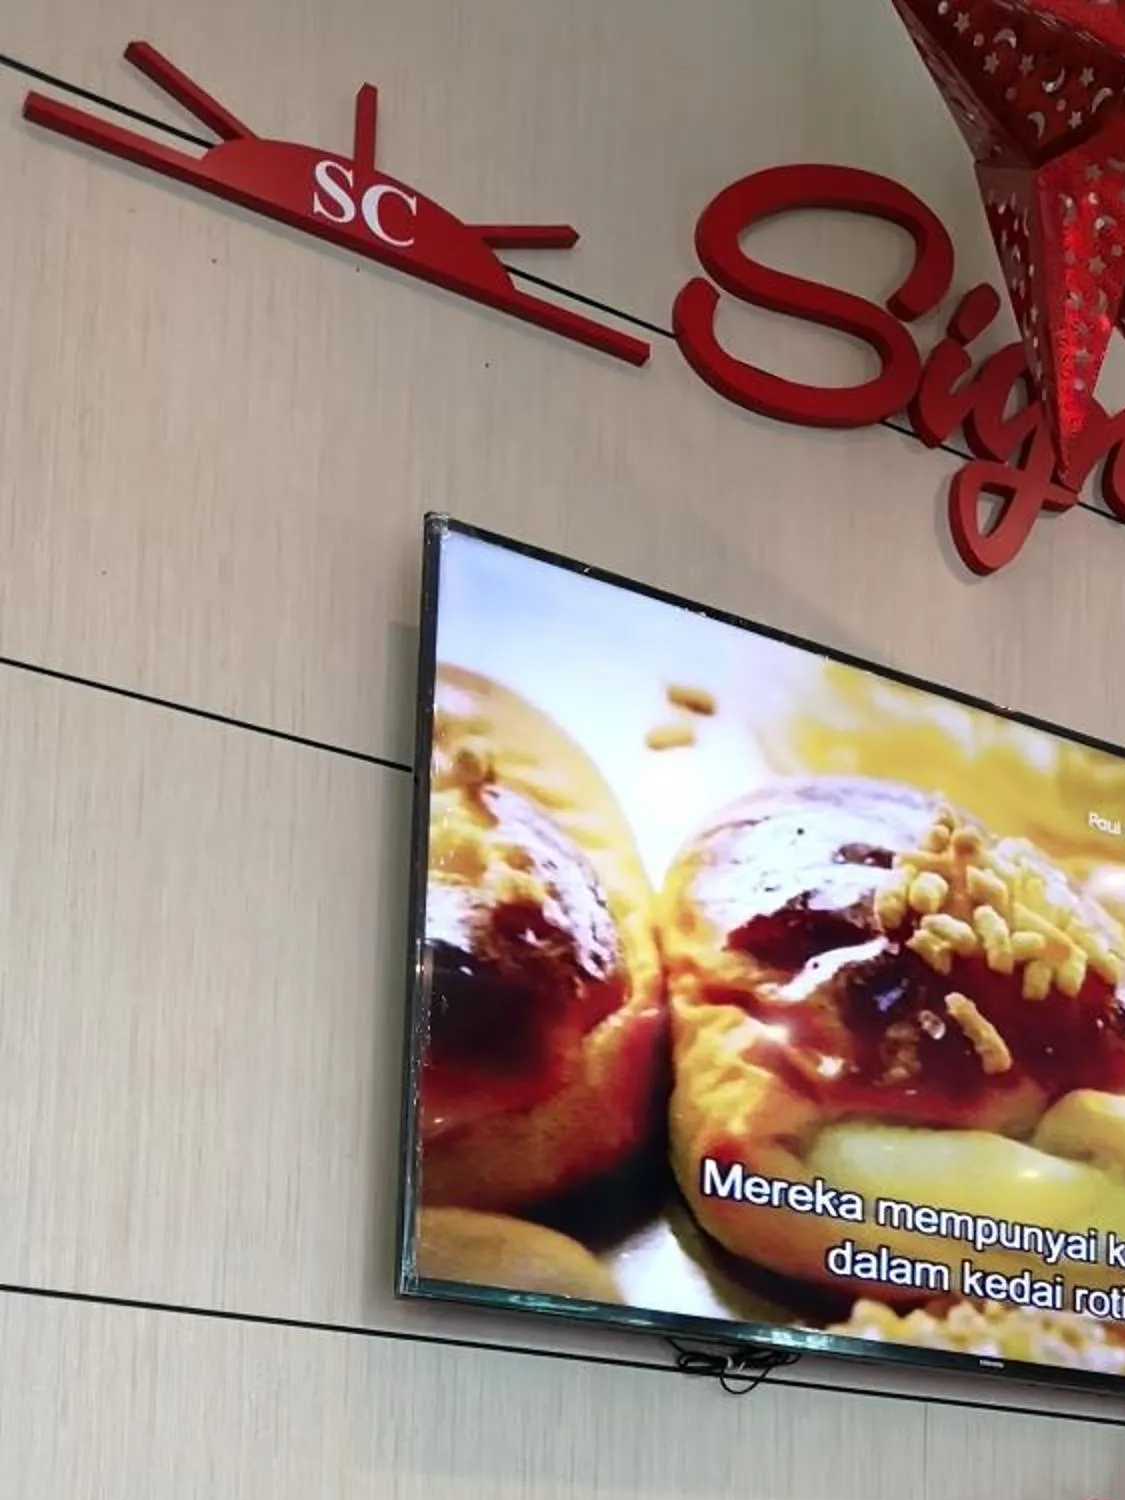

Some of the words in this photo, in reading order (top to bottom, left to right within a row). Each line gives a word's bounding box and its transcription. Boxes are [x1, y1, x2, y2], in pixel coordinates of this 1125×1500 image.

[313, 159, 417, 247] SC
[1088, 811, 1121, 835] Paul
[703, 1158, 863, 1221] Mereka
[877, 1199, 1096, 1264] mempunyai
[827, 1242, 949, 1291] dalam
[963, 1262, 1063, 1310] kedai
